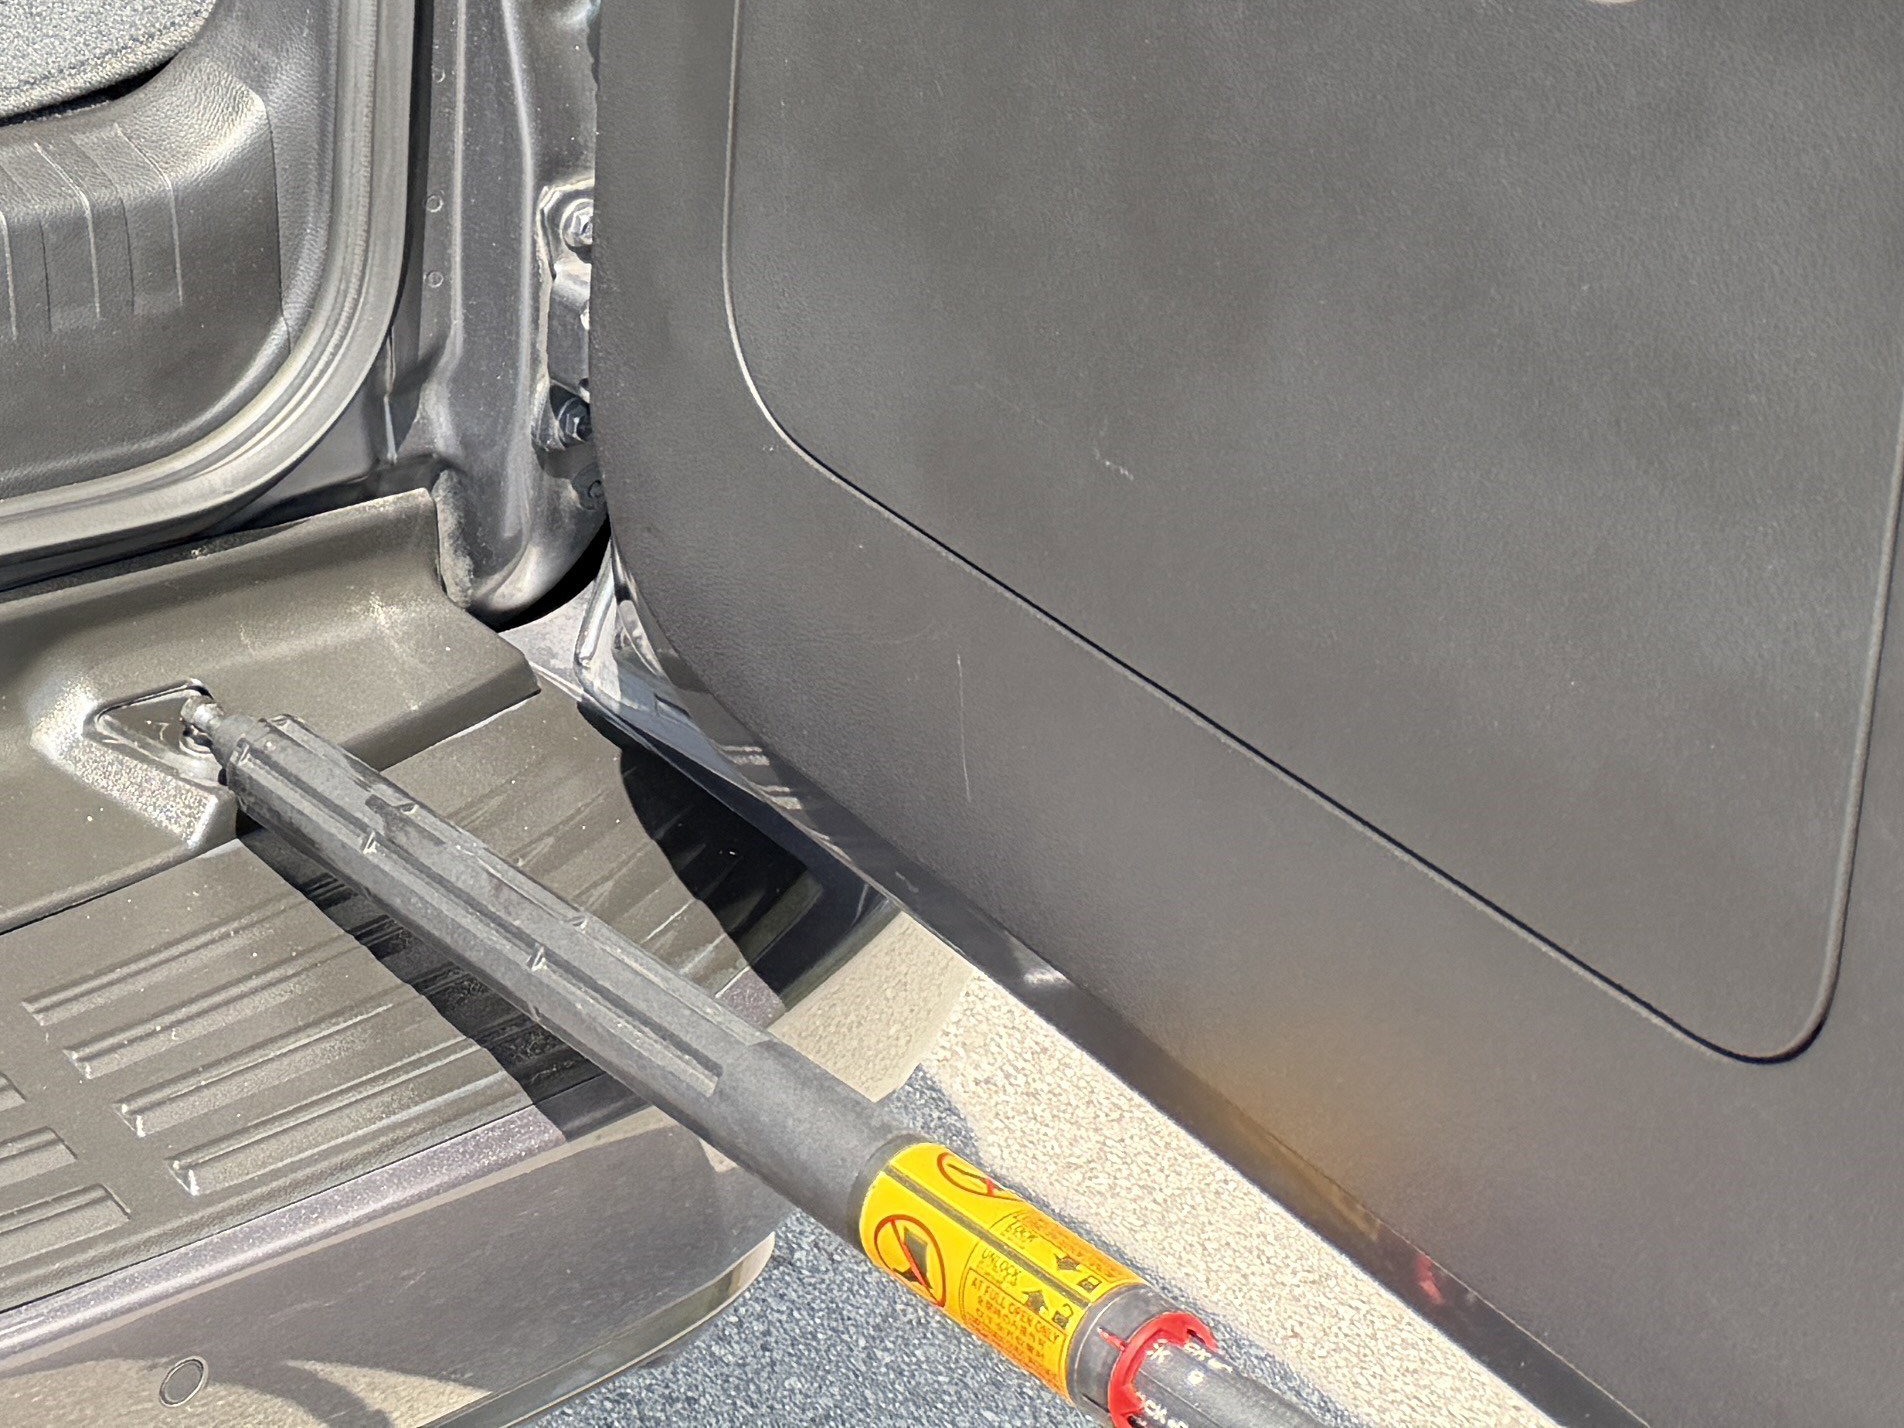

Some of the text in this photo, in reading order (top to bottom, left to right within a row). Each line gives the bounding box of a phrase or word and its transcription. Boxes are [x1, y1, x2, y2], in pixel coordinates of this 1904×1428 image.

[981, 1248, 1023, 1278] UNLOCK
[971, 1277, 984, 1291] AT
[984, 1285, 1007, 1310] FULL
[1008, 1302, 1034, 1328] OPEN
[1034, 1320, 1060, 1344] ONLY
